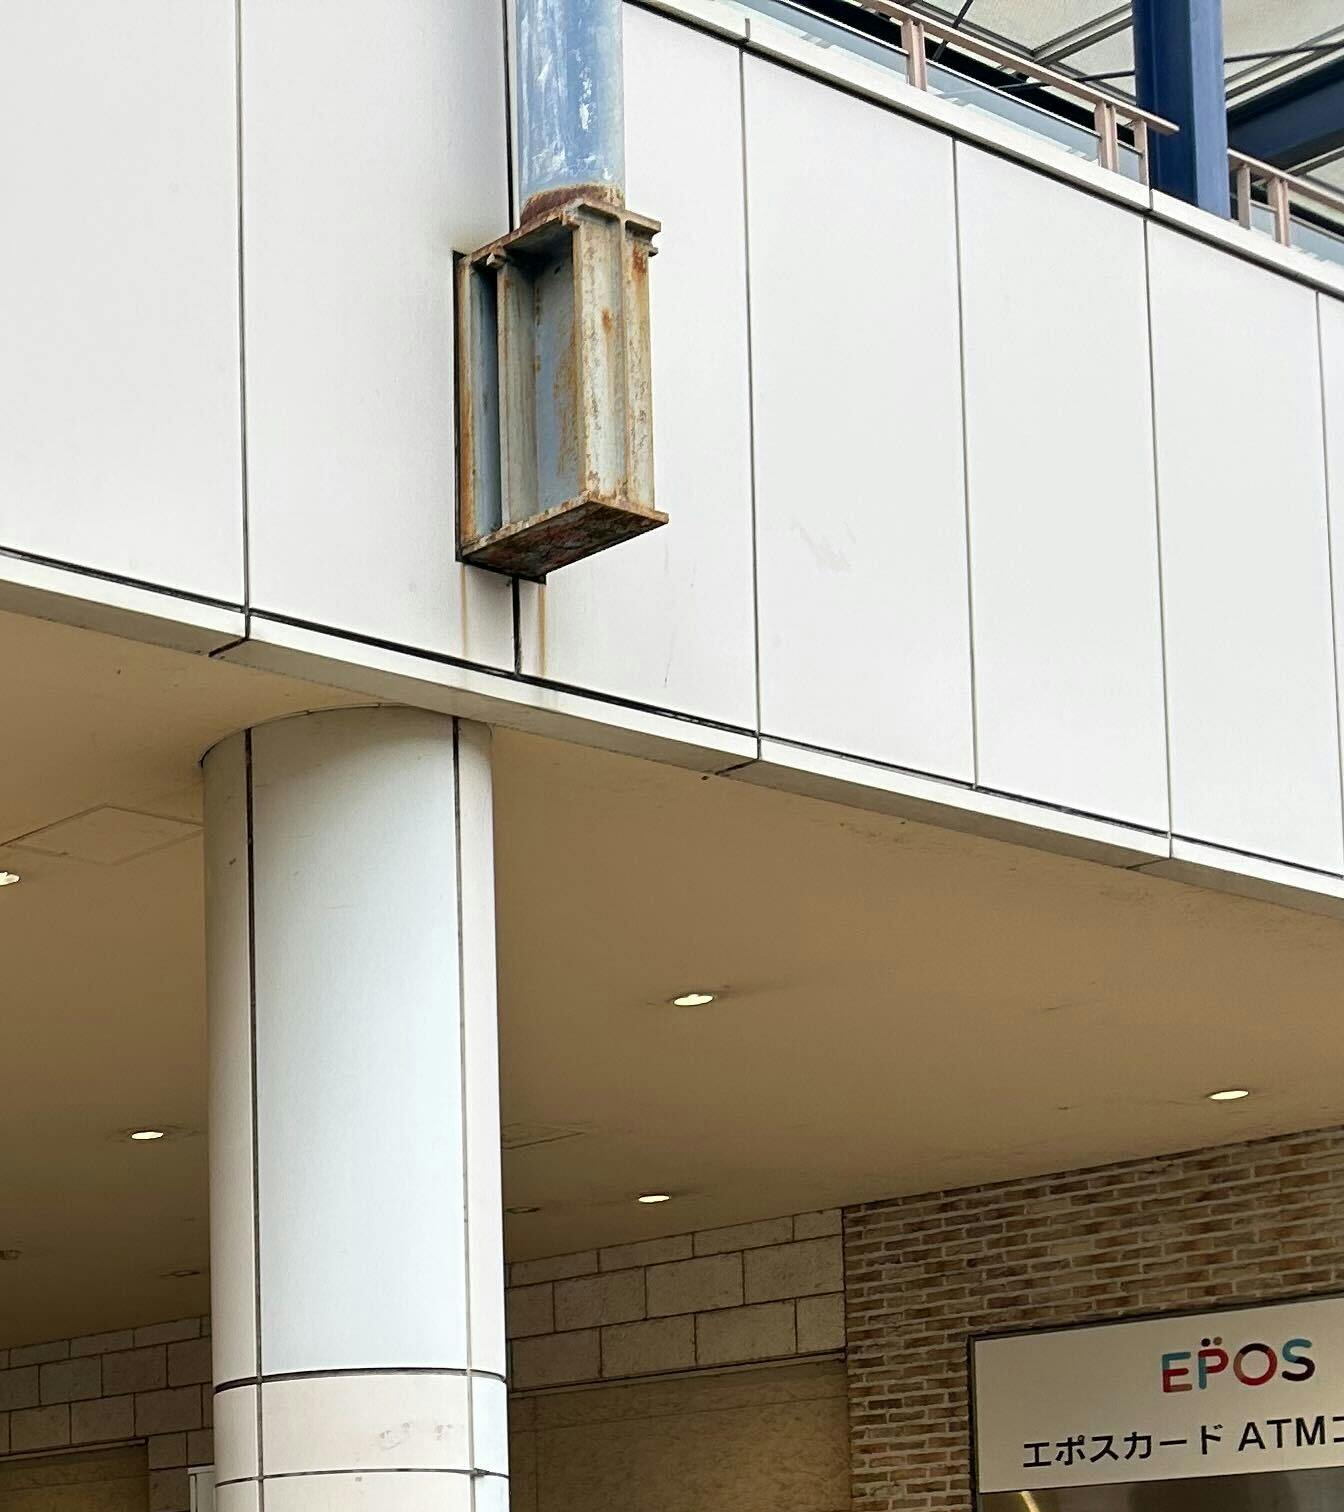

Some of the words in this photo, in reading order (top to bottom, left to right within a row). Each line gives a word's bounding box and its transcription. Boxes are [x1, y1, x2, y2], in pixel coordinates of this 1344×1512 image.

[1023, 1424, 1224, 1468] エポスカード
